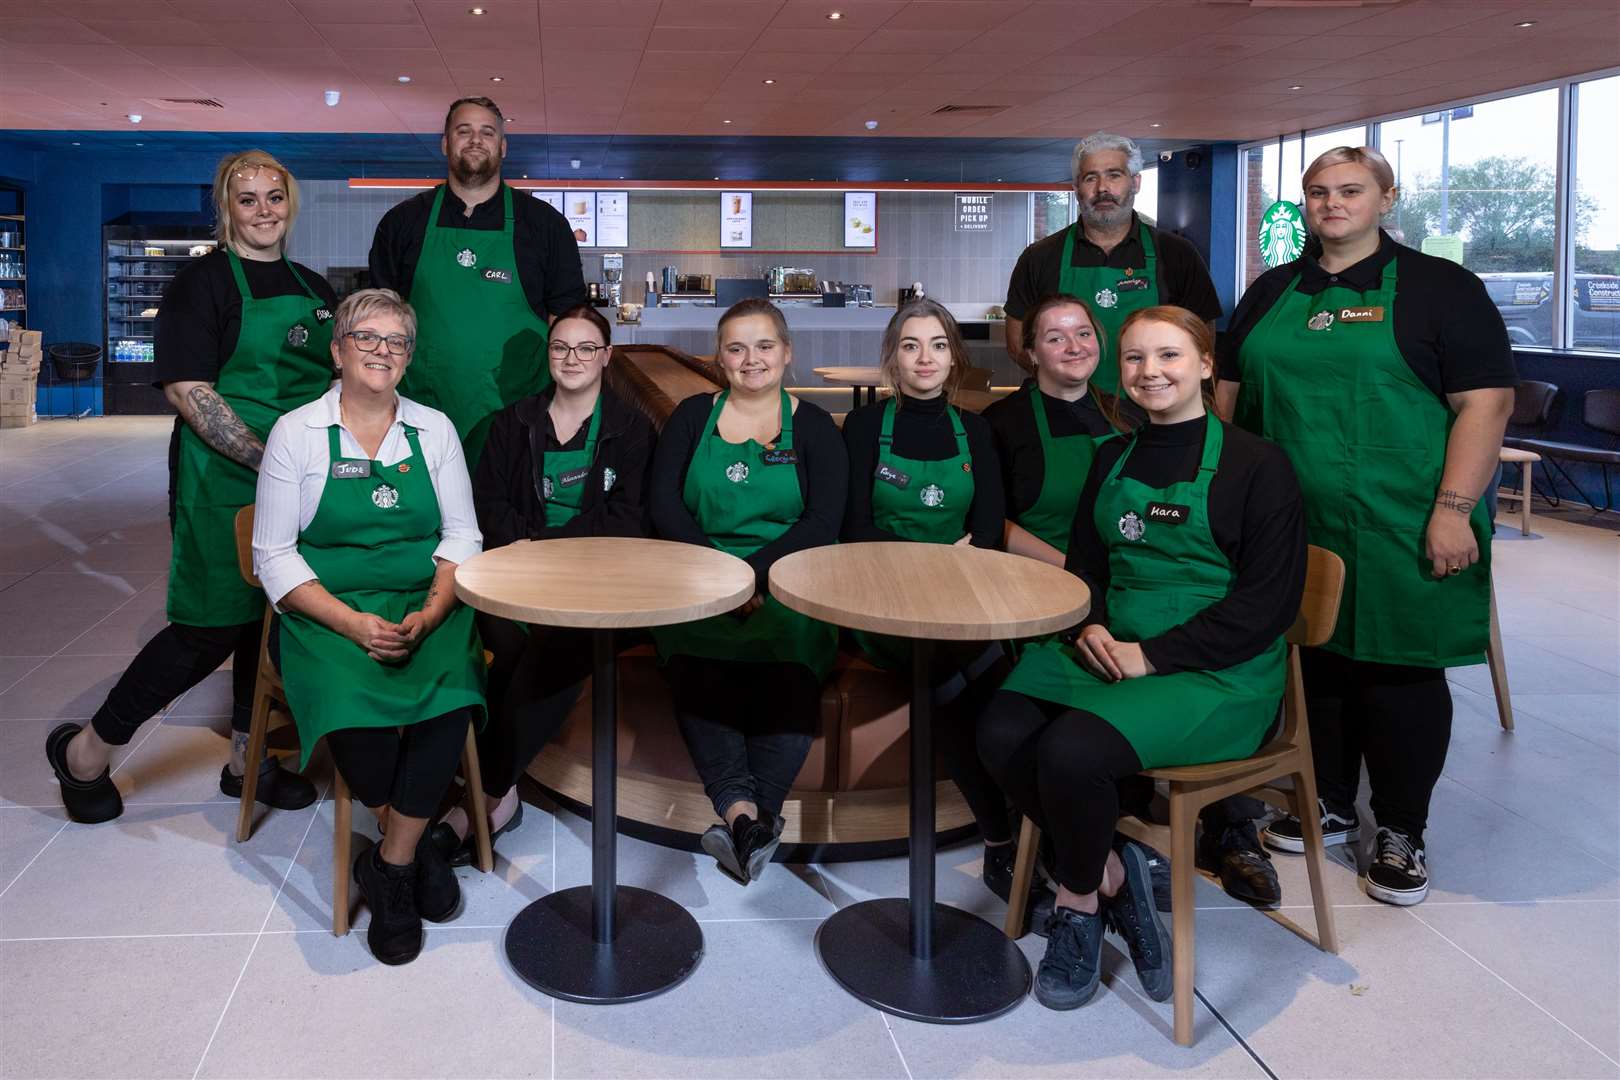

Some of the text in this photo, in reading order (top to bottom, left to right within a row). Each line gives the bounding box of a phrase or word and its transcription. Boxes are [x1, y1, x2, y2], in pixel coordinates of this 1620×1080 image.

[962, 205, 986, 213] ORDER
[960, 214, 988, 222] PICK UP
[485, 270, 508, 280] CARL
[1587, 280, 1619, 290] Creekside
[1341, 309, 1373, 319] Danni
